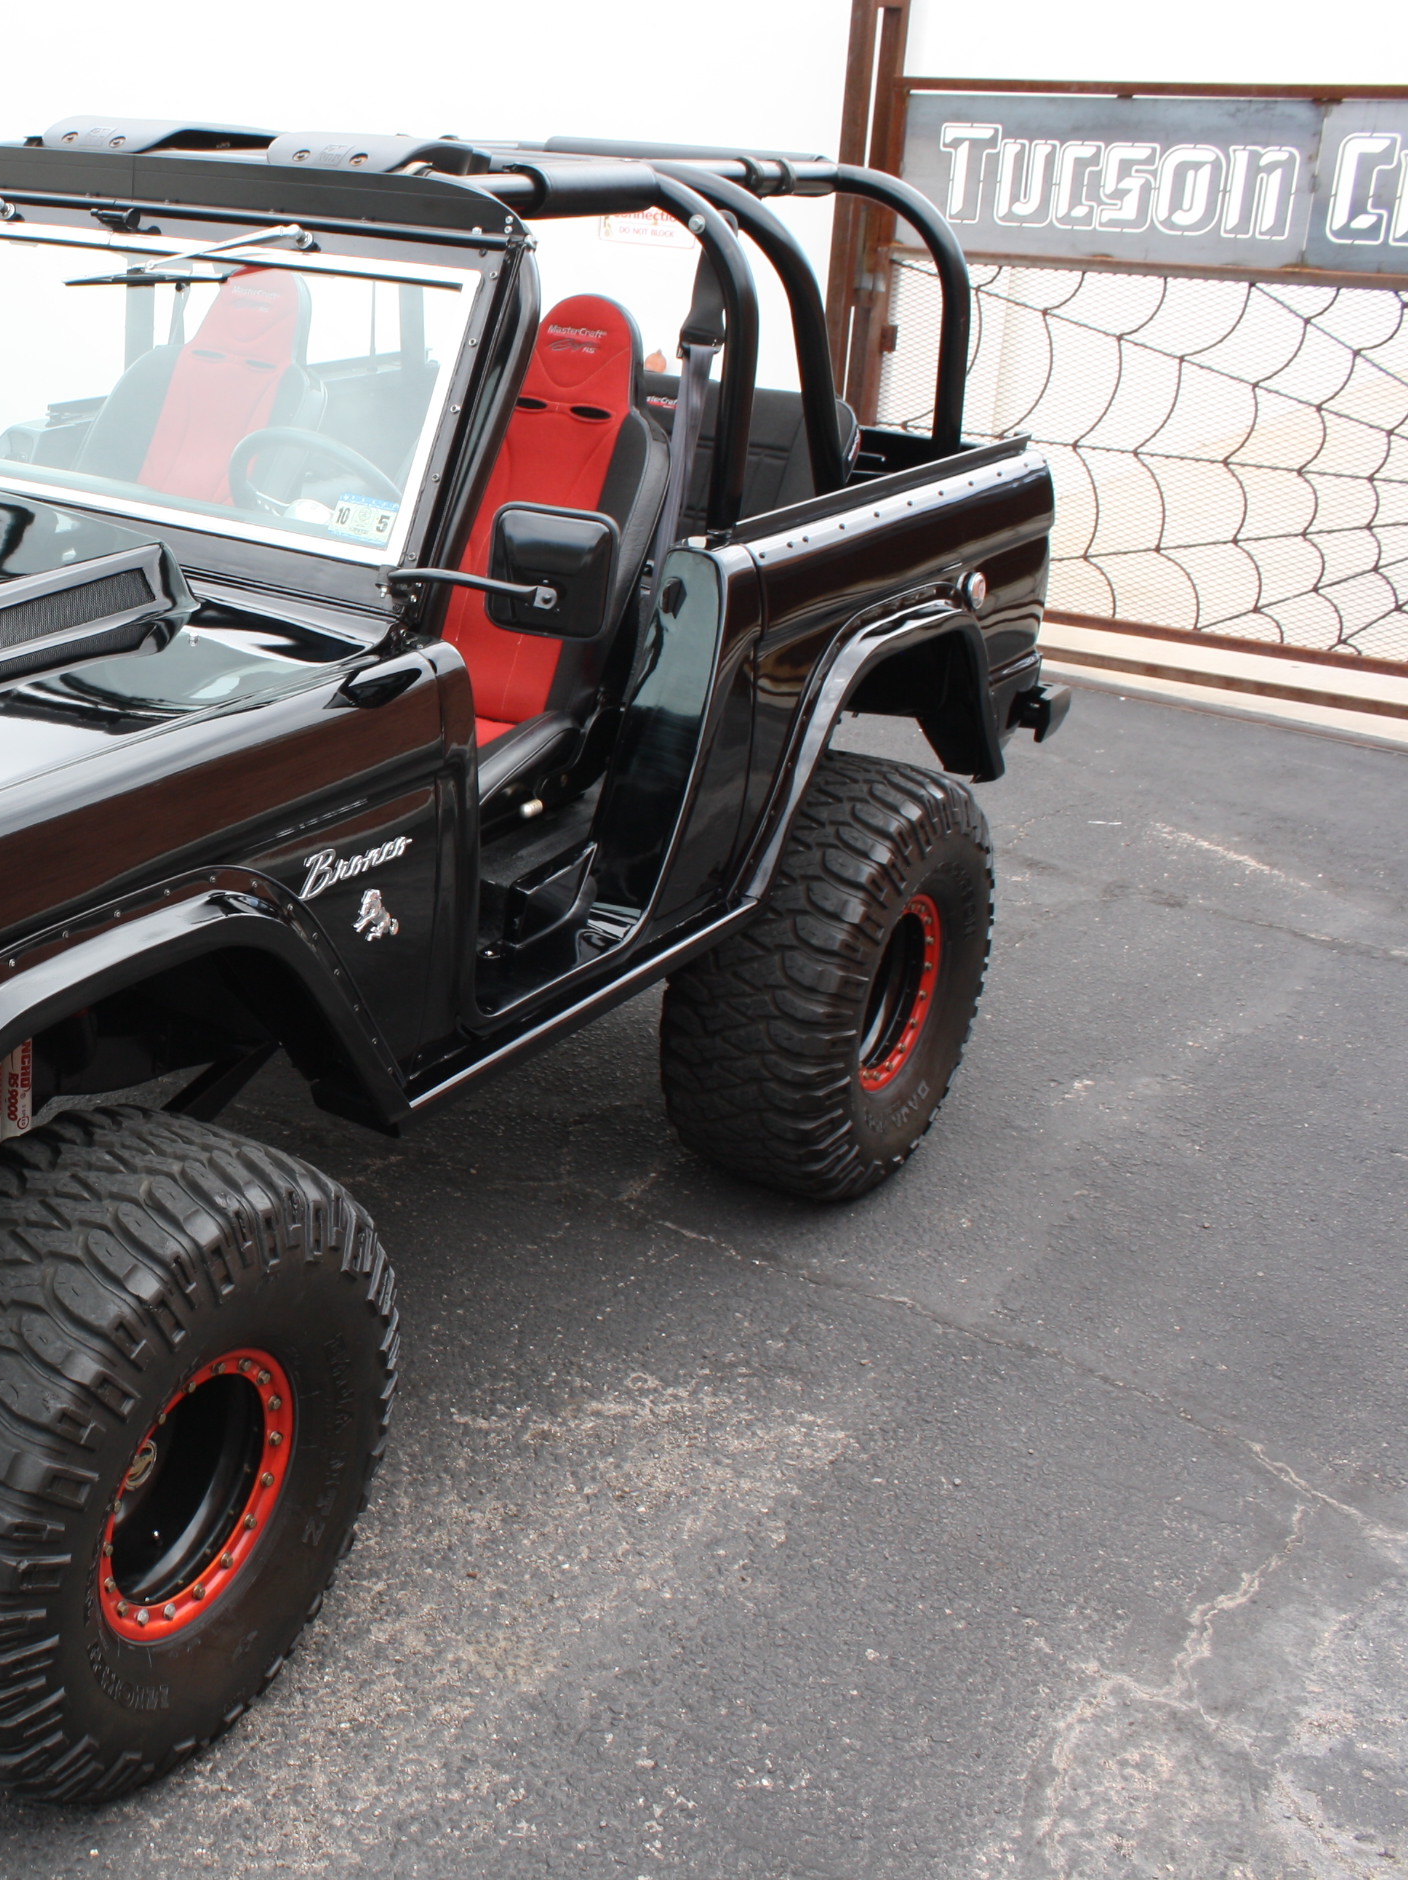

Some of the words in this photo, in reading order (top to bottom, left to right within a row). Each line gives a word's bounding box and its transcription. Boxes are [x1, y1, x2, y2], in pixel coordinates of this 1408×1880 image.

[1325, 132, 1408, 246] C
[336, 507, 350, 525] 10
[376, 514, 390, 533] 5
[298, 836, 413, 901] Bronco
[20, 1041, 32, 1089] NCHO
